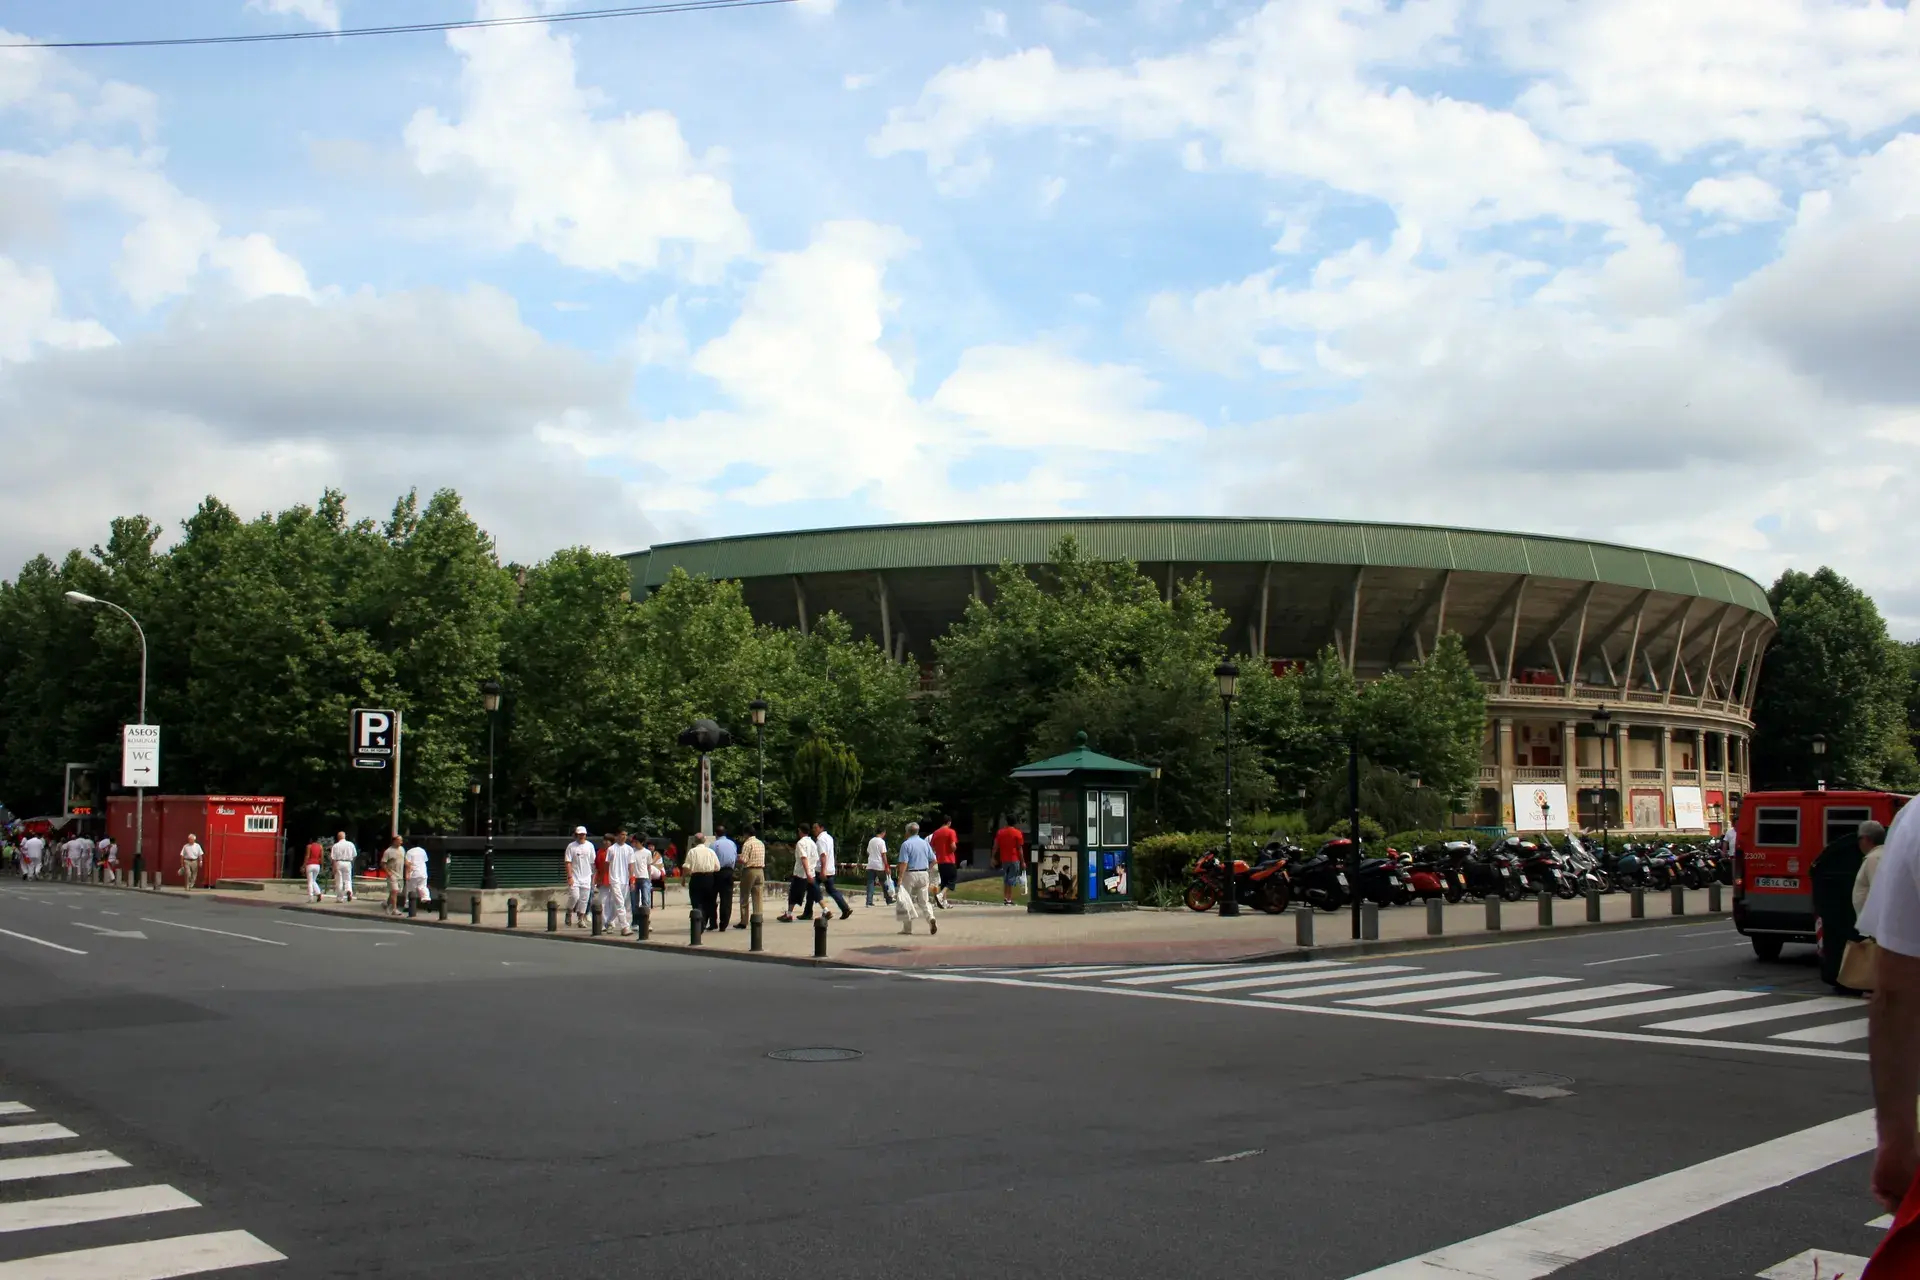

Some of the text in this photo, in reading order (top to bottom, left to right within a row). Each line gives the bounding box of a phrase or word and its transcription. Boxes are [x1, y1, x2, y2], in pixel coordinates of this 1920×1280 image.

[128, 728, 158, 736] ASEOS
[361, 712, 389, 746] P
[132, 751, 153, 761] WC
[251, 805, 273, 814] WC
[1743, 852, 1766, 860] Z3070
